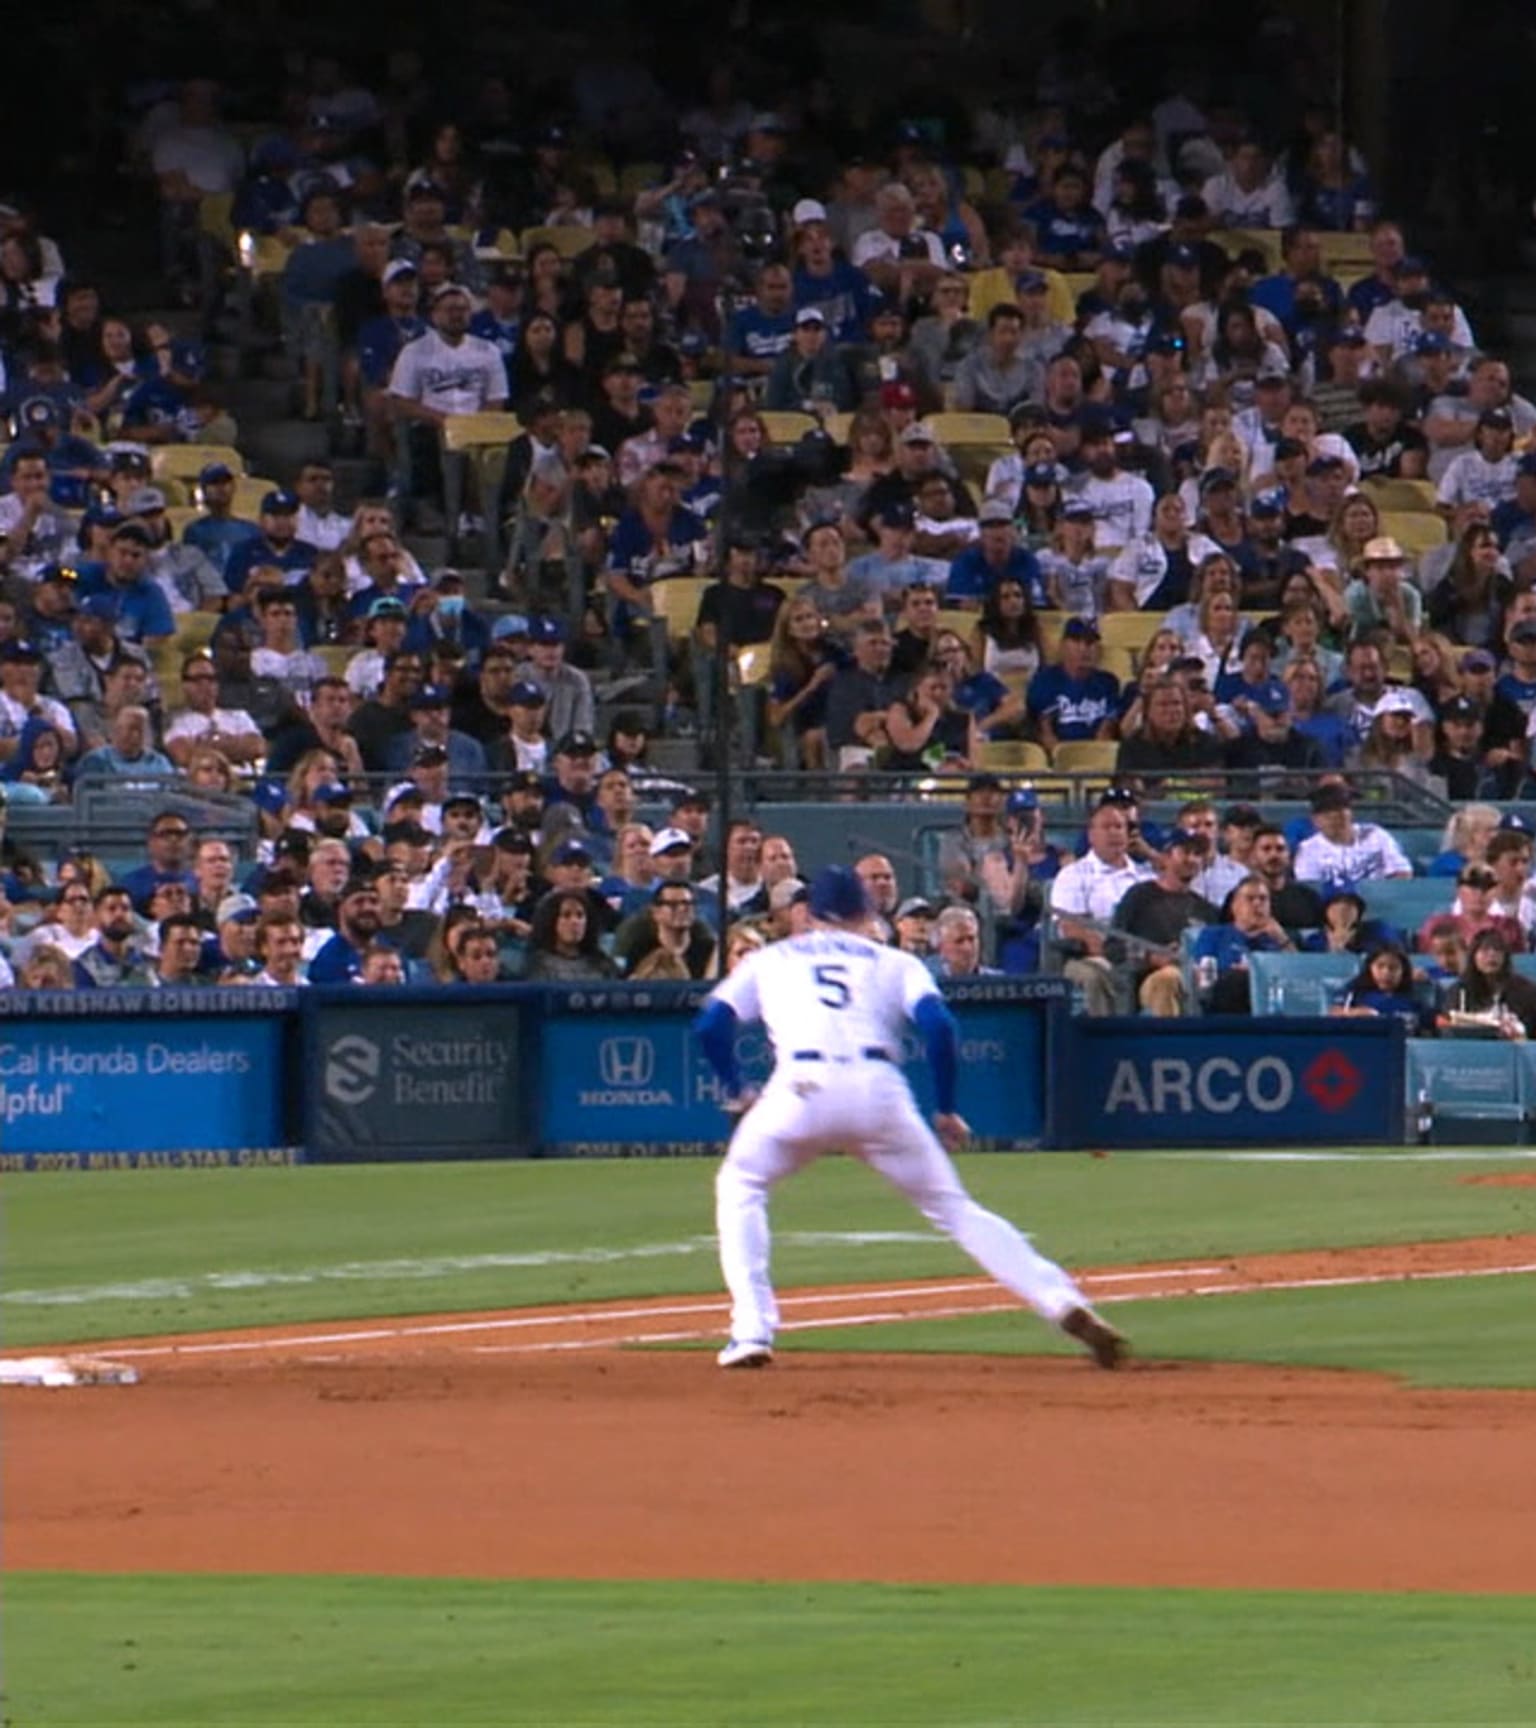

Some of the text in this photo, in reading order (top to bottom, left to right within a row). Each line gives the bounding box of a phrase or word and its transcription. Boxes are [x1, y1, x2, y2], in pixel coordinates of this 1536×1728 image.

[37, 992, 142, 1012] KERSHAW
[149, 990, 288, 1011] BOBBLEHEAD
[813, 964, 851, 1009] 5
[49, 1043, 139, 1075] Honda
[146, 1041, 250, 1075] Dealers
[392, 1032, 509, 1067] Security
[395, 1069, 497, 1104] Benefit
[577, 1090, 675, 1106] HONDA
[1104, 1056, 1293, 1114] ARCO
